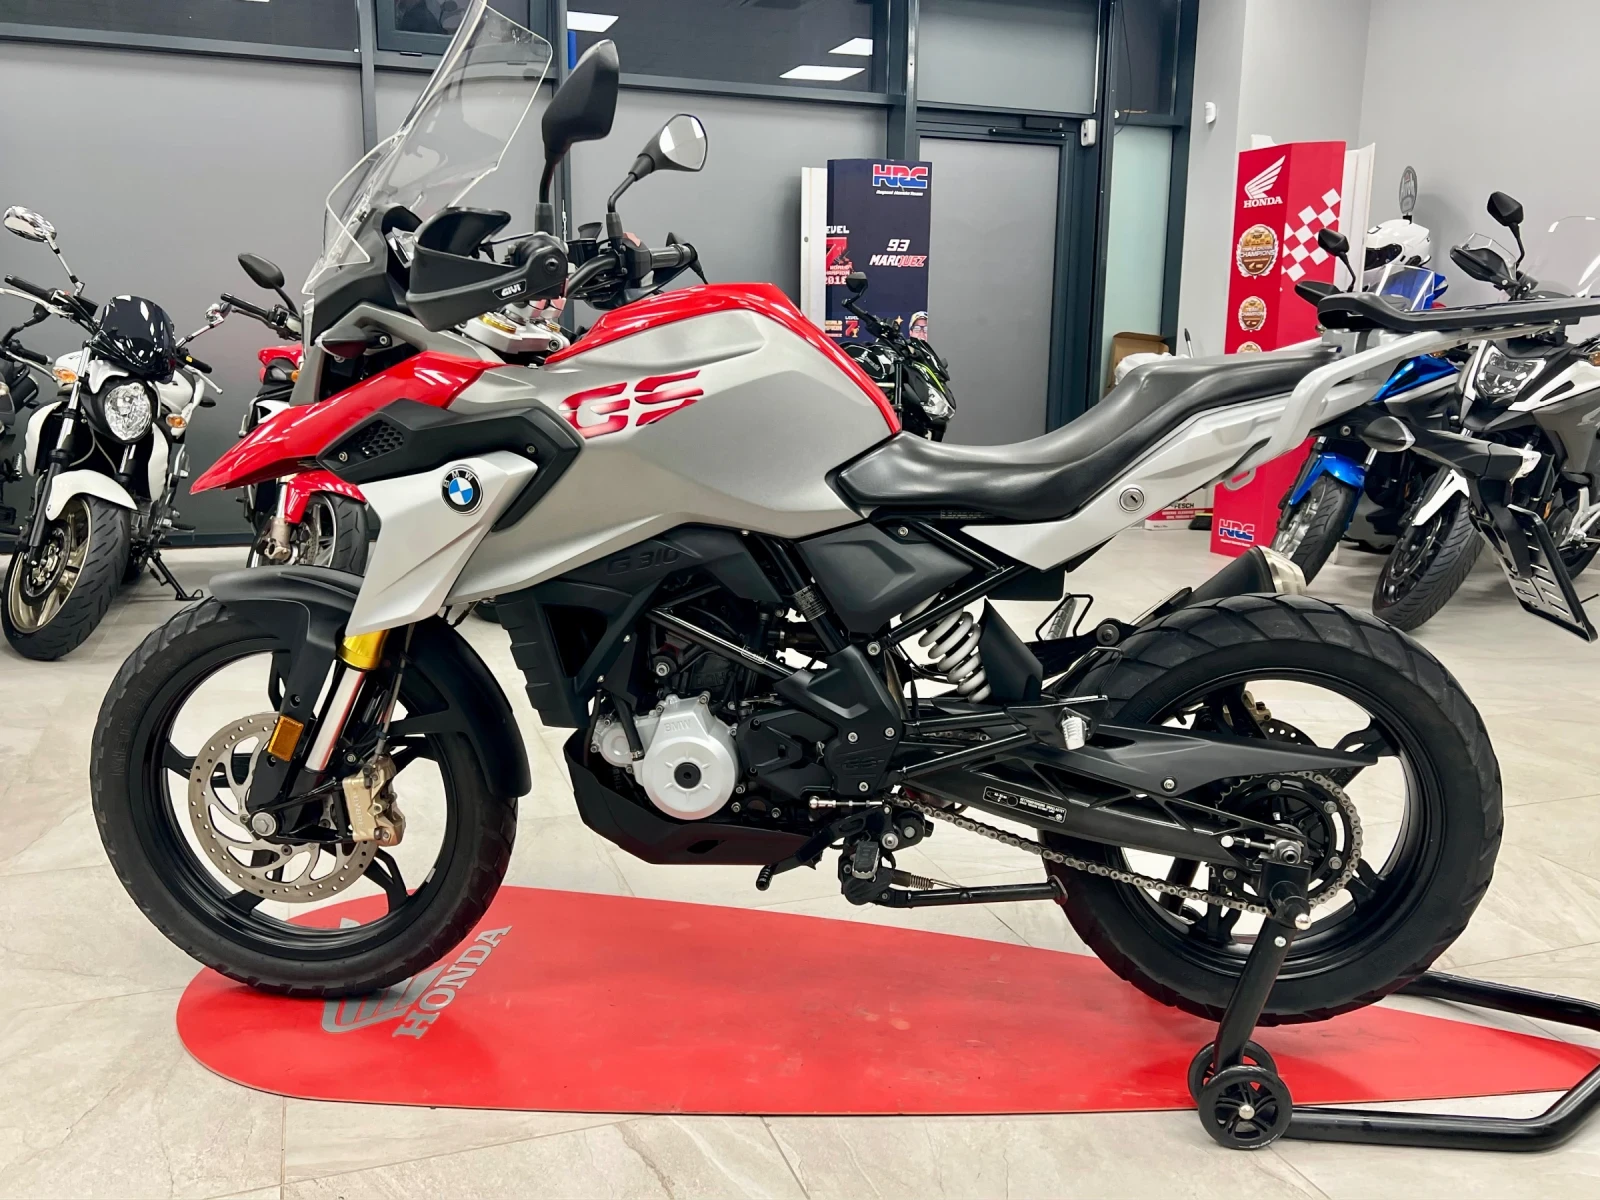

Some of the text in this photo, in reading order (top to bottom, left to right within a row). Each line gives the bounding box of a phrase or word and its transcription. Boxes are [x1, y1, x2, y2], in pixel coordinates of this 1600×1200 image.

[873, 164, 928, 189] HRC
[1243, 196, 1284, 209] HONDA
[826, 225, 850, 234] EVEL
[886, 238, 910, 252] 93
[869, 254, 928, 268] MARQUEZ
[501, 283, 522, 297] GIVI
[558, 369, 705, 440] GS
[443, 469, 475, 489] BMW
[1218, 518, 1255, 543] HRC
[606, 546, 680, 576] G 310
[391, 925, 513, 1040] HONDA
